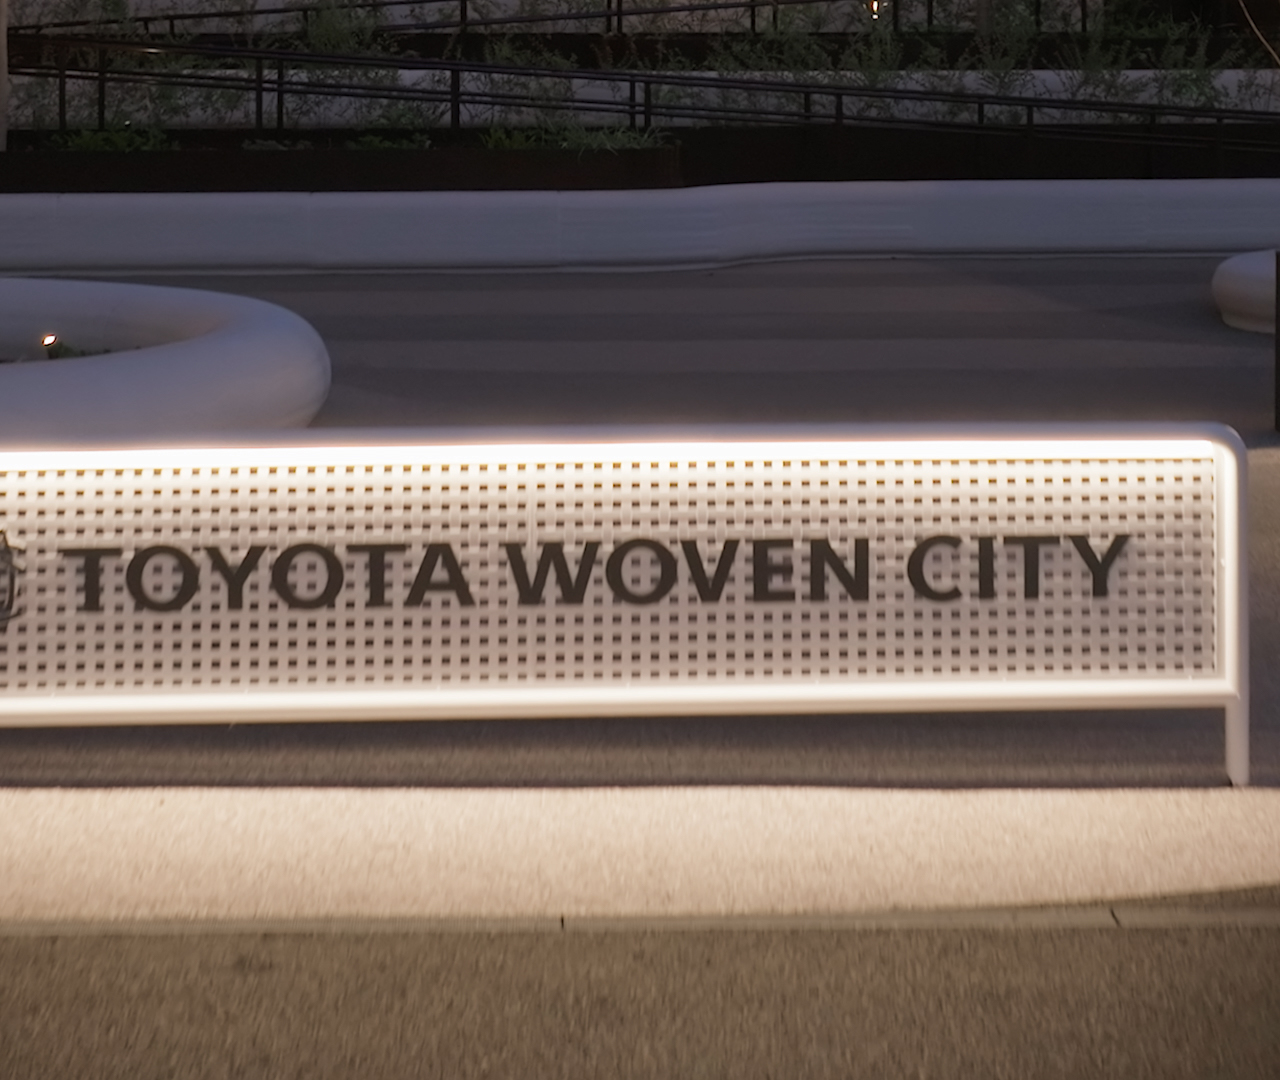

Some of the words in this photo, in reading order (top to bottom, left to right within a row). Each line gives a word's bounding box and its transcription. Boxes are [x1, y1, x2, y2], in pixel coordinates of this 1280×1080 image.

[60, 542, 476, 612] TOYOTA
[505, 538, 870, 606] WOVEN
[907, 534, 1131, 602] CITY
